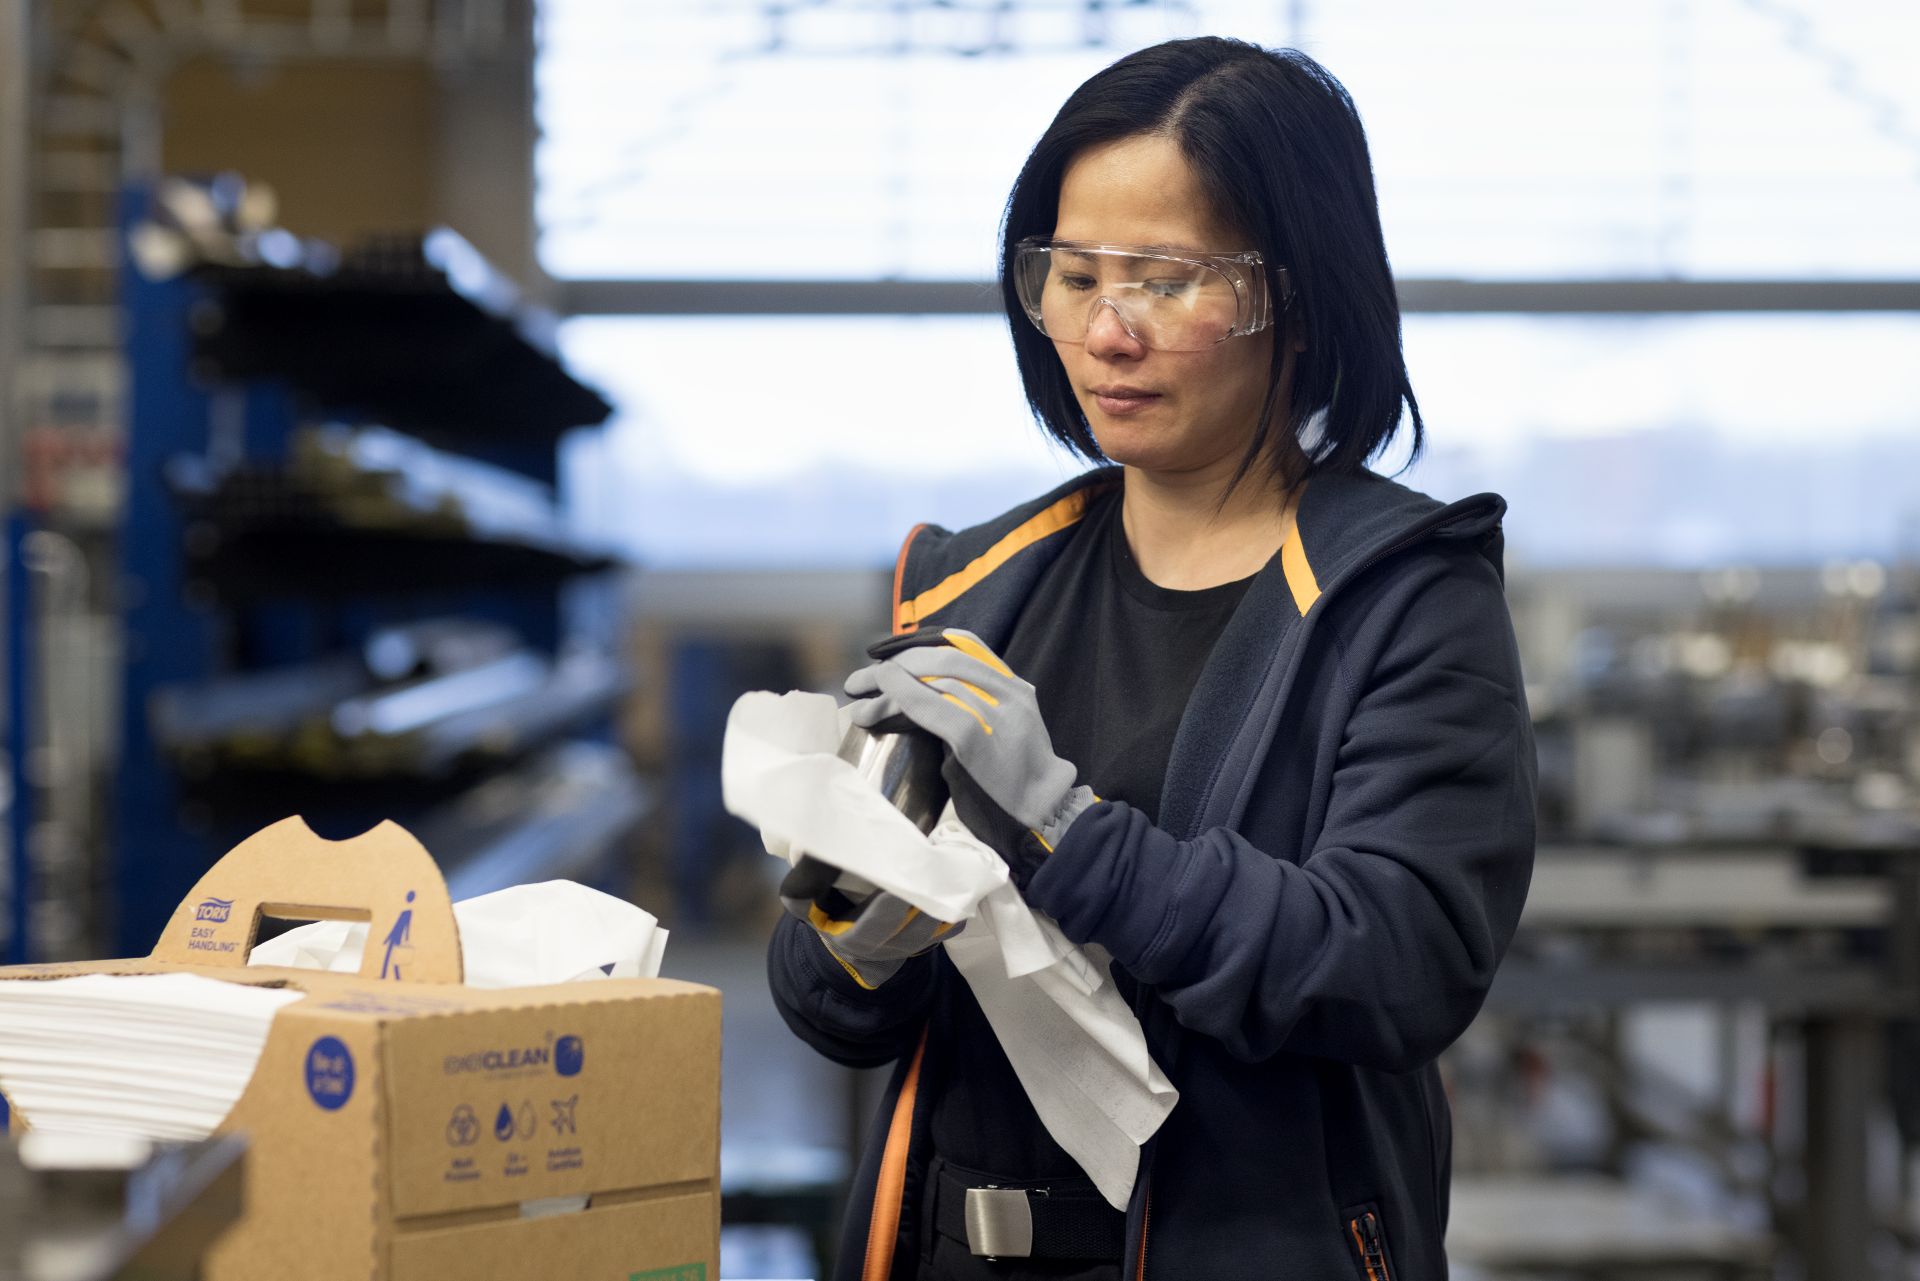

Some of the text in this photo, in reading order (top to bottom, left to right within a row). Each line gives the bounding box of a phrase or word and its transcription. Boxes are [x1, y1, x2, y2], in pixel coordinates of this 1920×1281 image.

[197, 905, 230, 920] TORK
[191, 927, 216, 938] EASY
[443, 1048, 549, 1074] CLEAN
